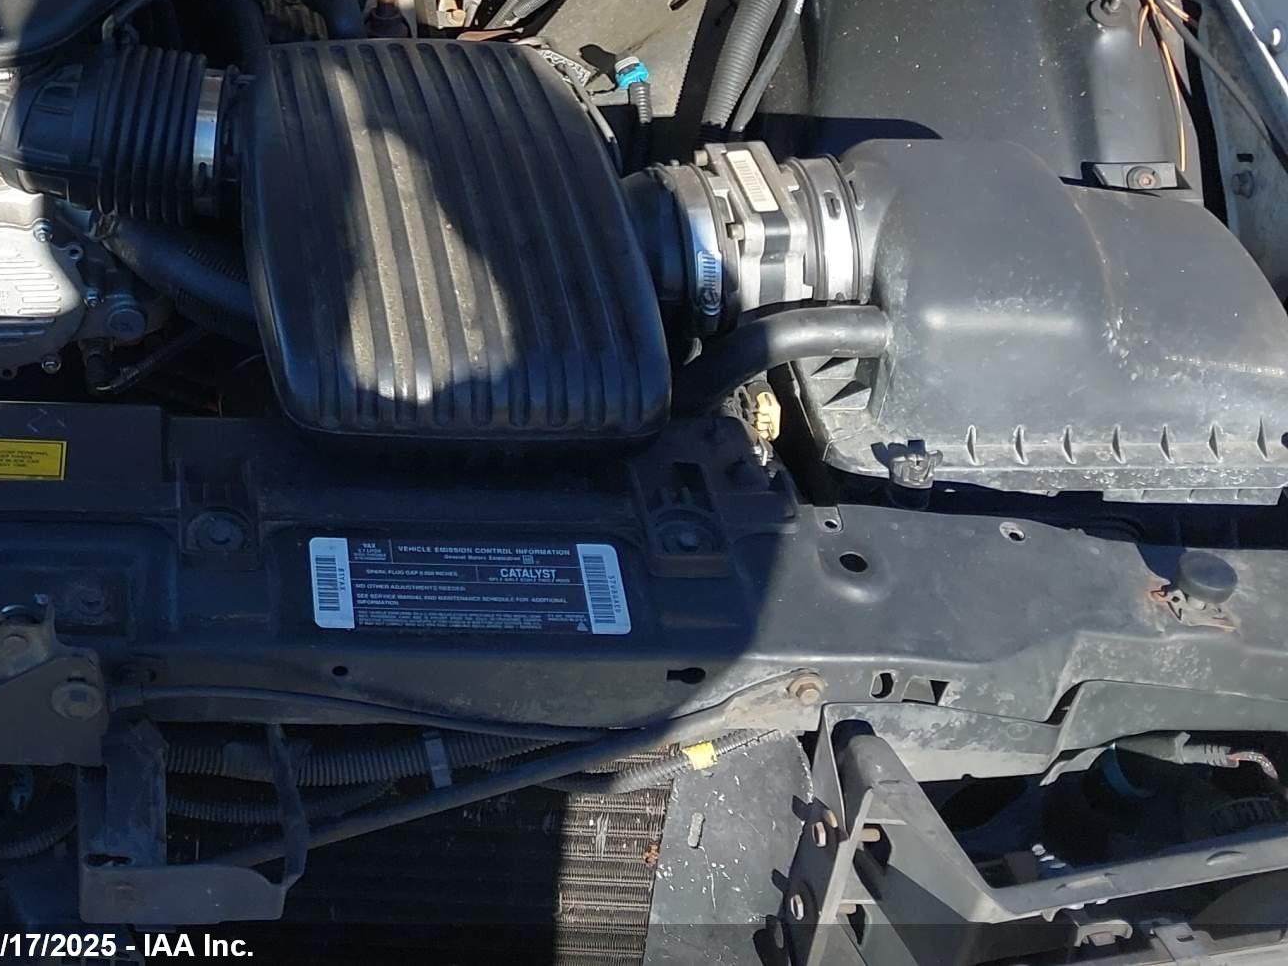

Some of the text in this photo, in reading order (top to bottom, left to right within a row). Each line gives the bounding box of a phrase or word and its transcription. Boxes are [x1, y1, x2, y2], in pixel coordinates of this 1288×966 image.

[397, 545, 571, 556] VEHICLE EMISSION CONTROL INFORMATION
[500, 568, 557, 579] CATALYST
